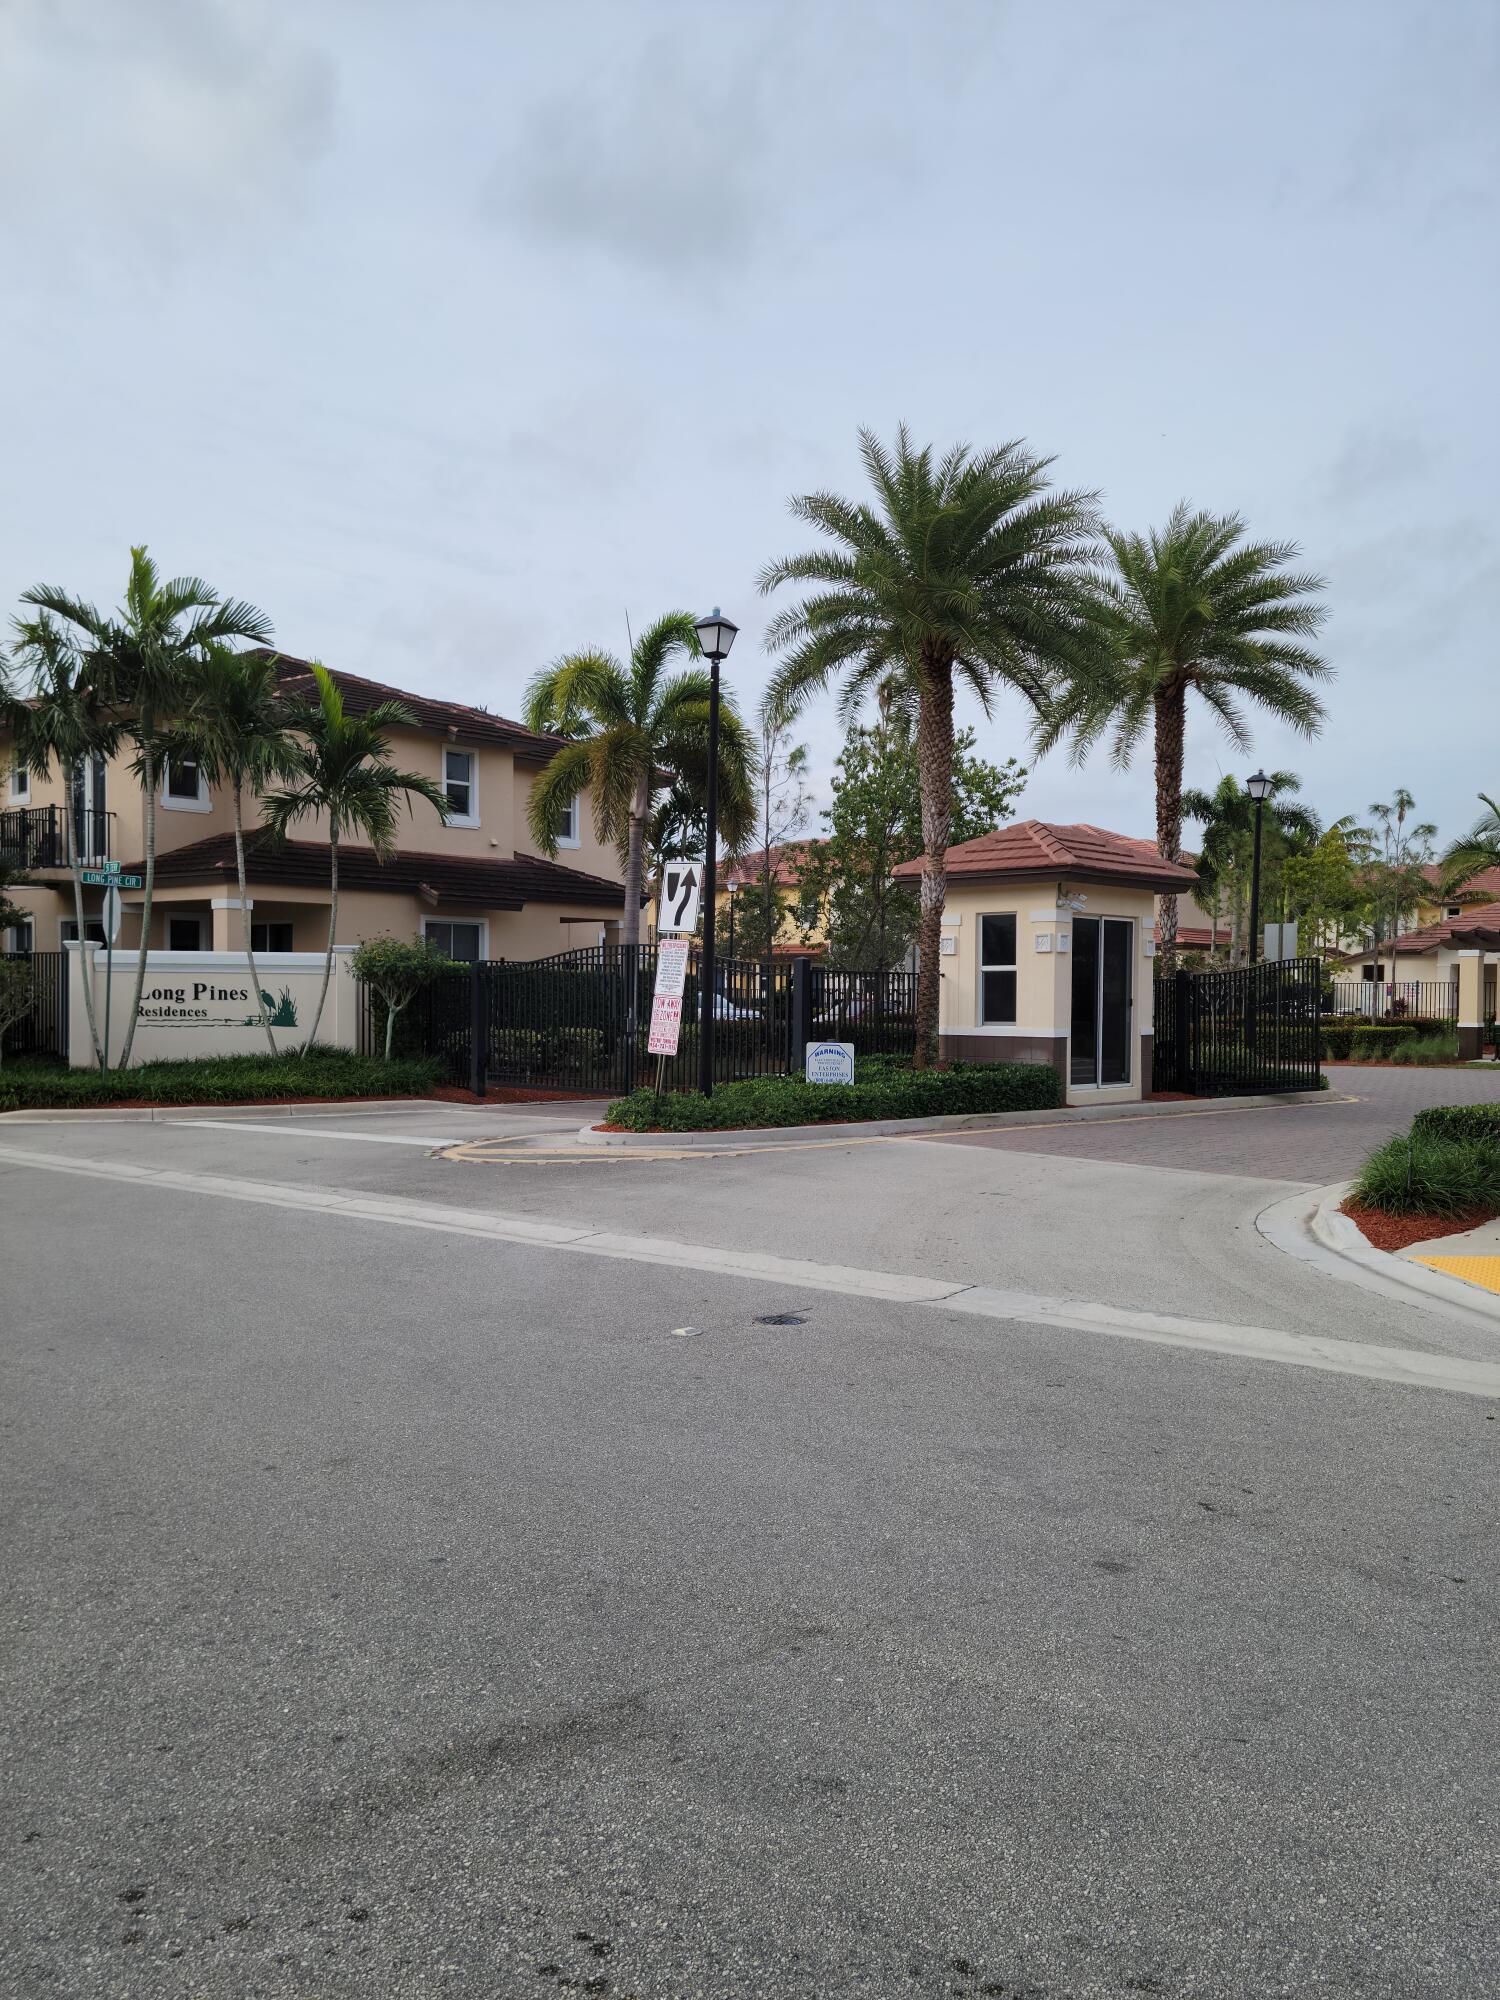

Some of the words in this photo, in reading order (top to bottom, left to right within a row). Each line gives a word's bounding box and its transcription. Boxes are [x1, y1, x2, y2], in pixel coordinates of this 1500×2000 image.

[87, 873, 105, 883] LONG
[107, 875, 123, 885] PINE
[125, 877, 137, 886] CIR
[192, 982, 248, 1001] Pines
[137, 1006, 208, 1017] Residences
[660, 1010, 673, 1021] ZONE
[814, 1049, 846, 1059] WARNING
